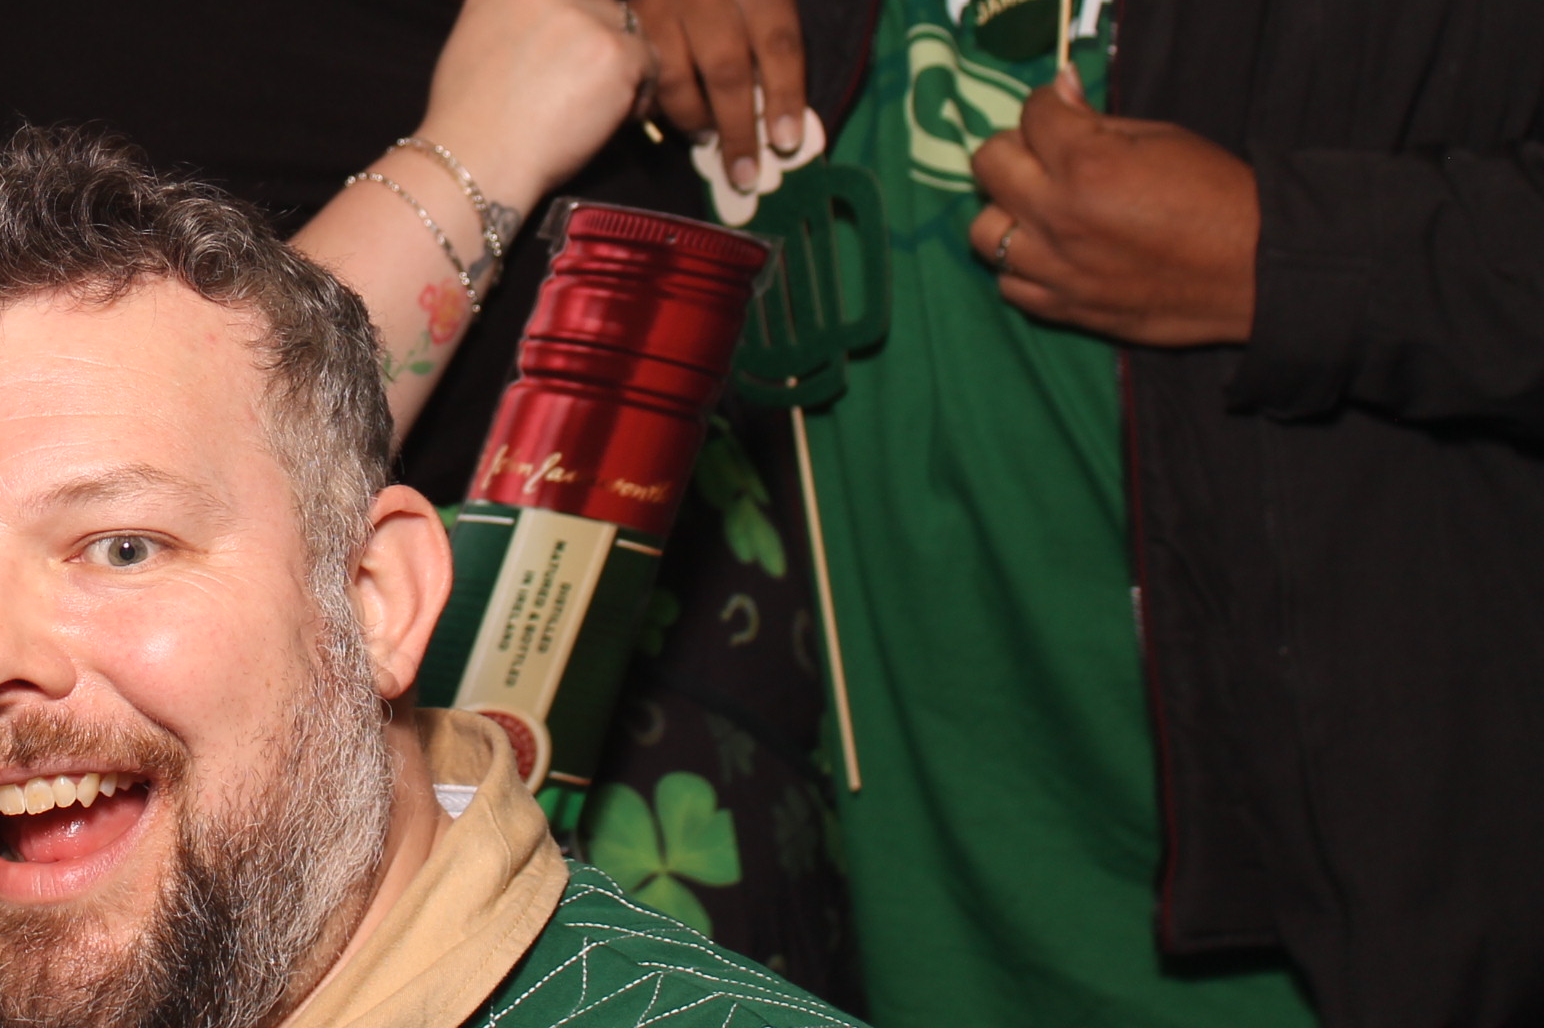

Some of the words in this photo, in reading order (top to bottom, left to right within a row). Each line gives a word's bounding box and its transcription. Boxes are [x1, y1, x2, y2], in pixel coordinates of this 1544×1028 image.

[522, 570, 535, 586] IN
[533, 539, 567, 609] MATURED
[497, 588, 529, 653] IRELAND
[538, 581, 572, 655] DISTILLED
[504, 624, 537, 688] BOTTLED
